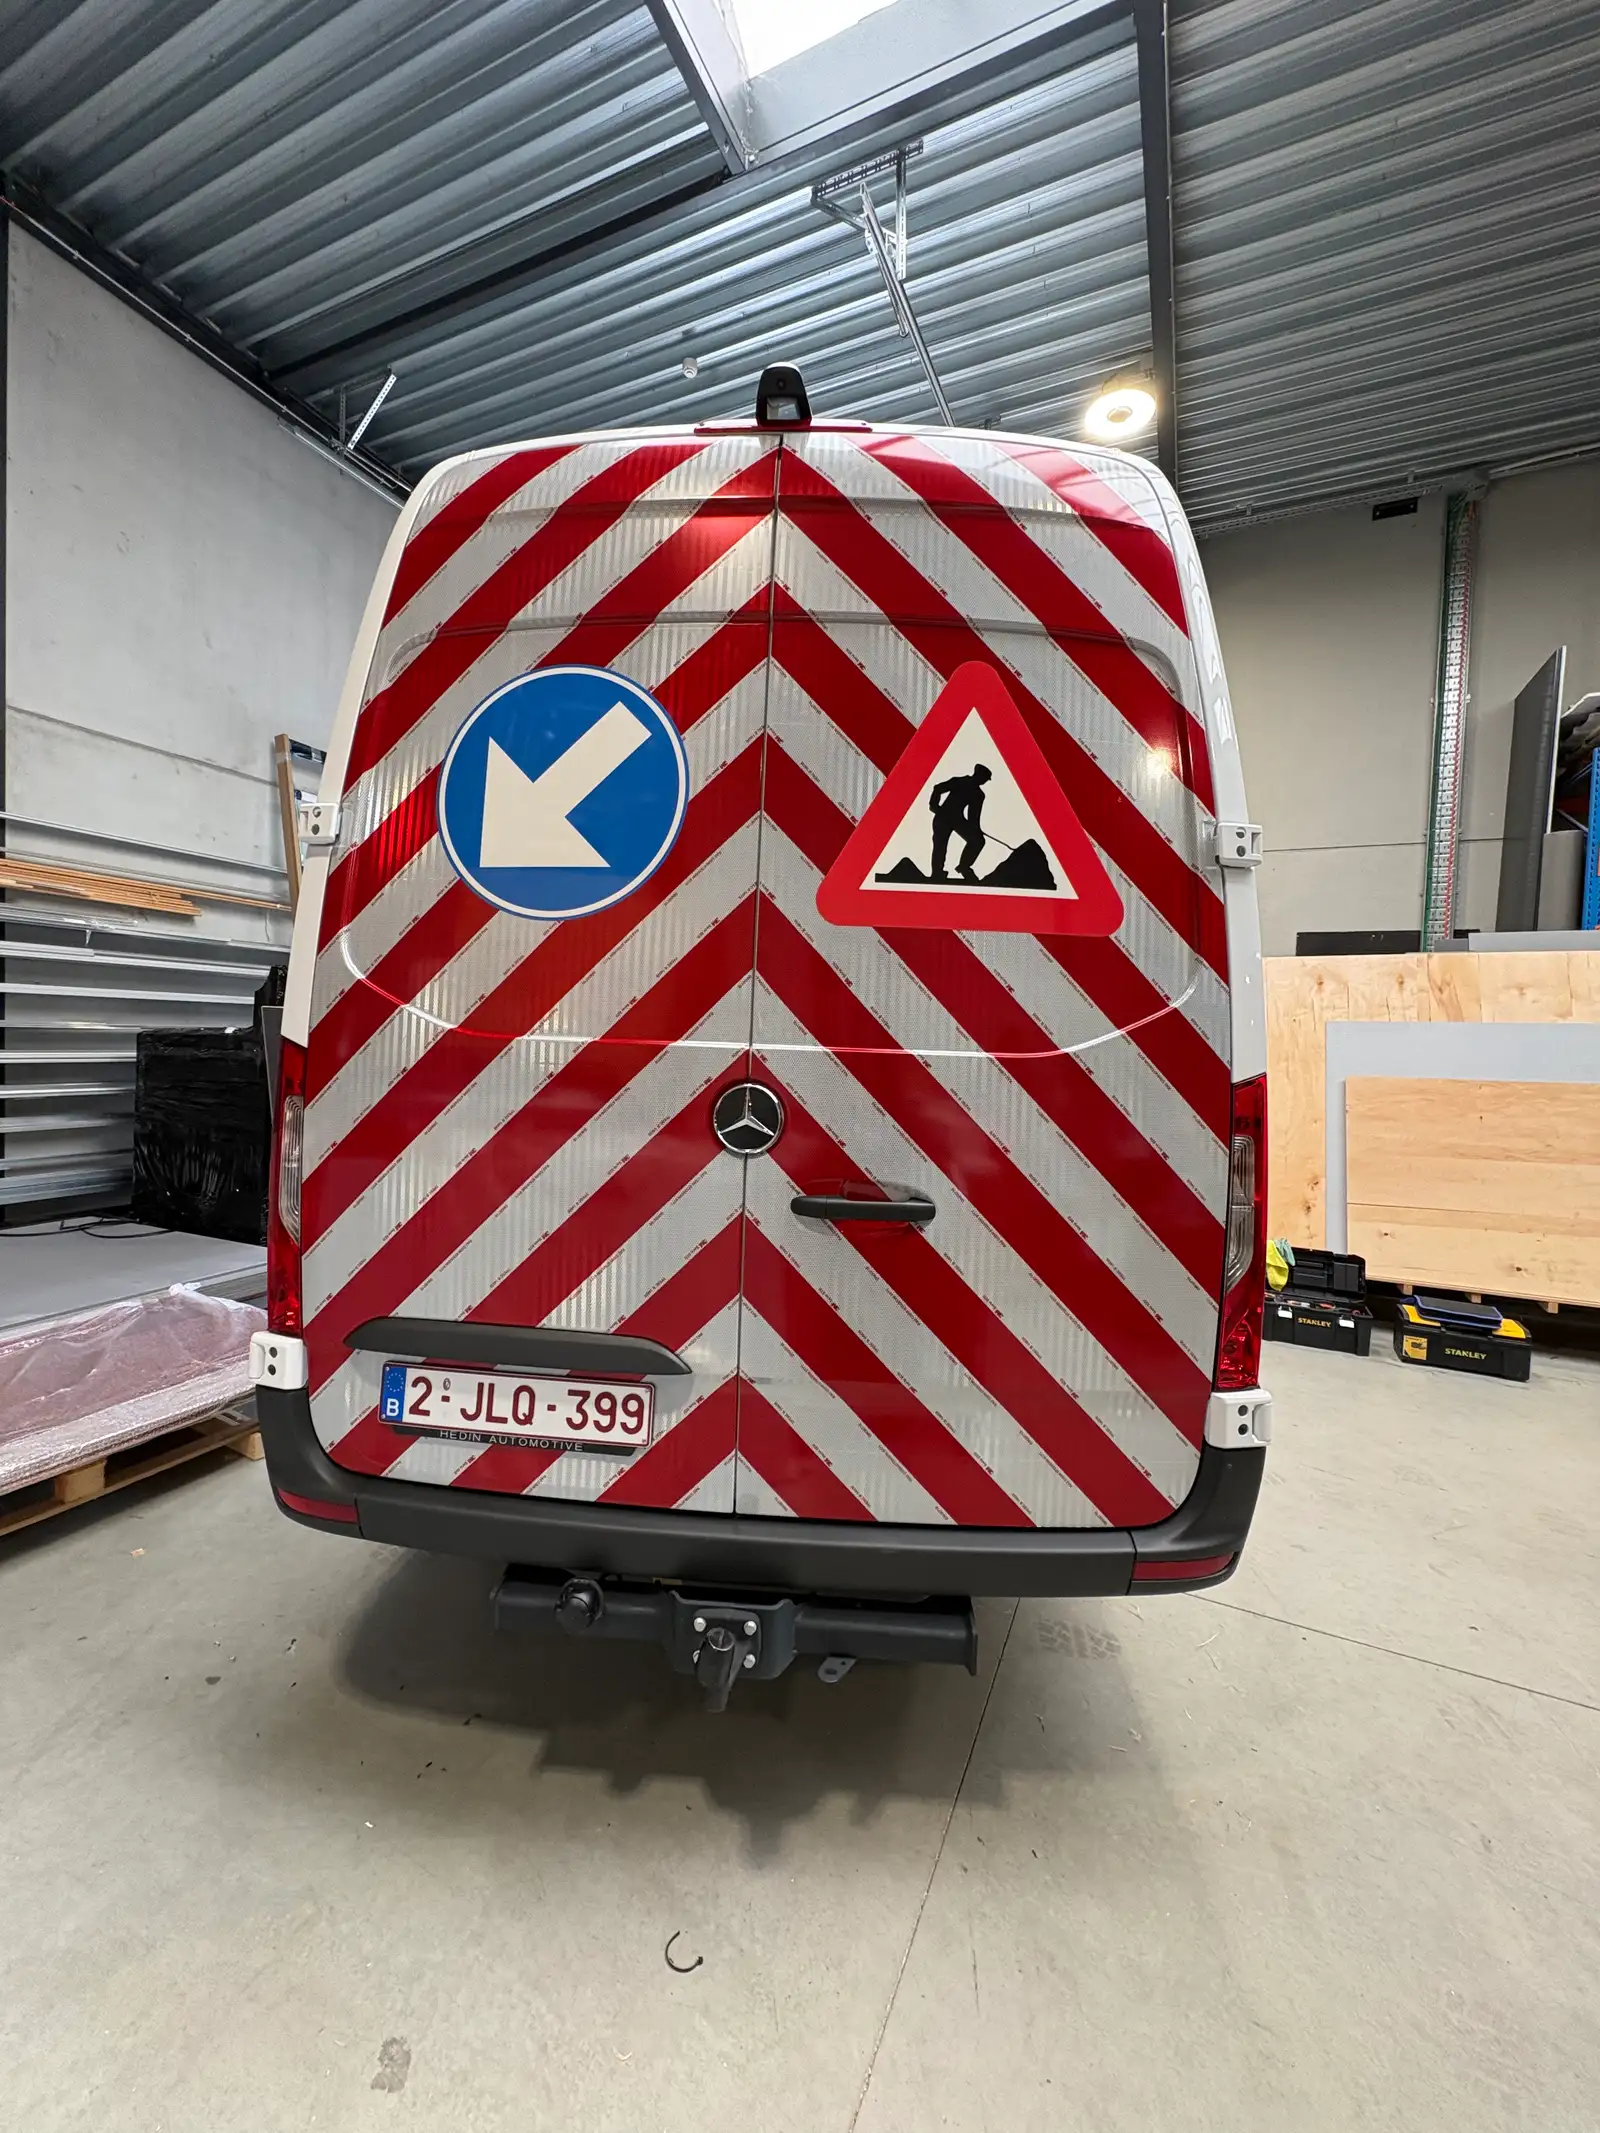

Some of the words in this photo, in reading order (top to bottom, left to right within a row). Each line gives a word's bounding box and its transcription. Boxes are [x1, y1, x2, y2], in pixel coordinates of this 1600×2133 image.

[1297, 1317, 1332, 1328] STANLEY
[1444, 1347, 1487, 1360] STANLEY
[386, 1398, 399, 1417] B
[440, 1430, 481, 1442] HEDIN
[489, 1435, 583, 1452] AUTOMOTIVE
